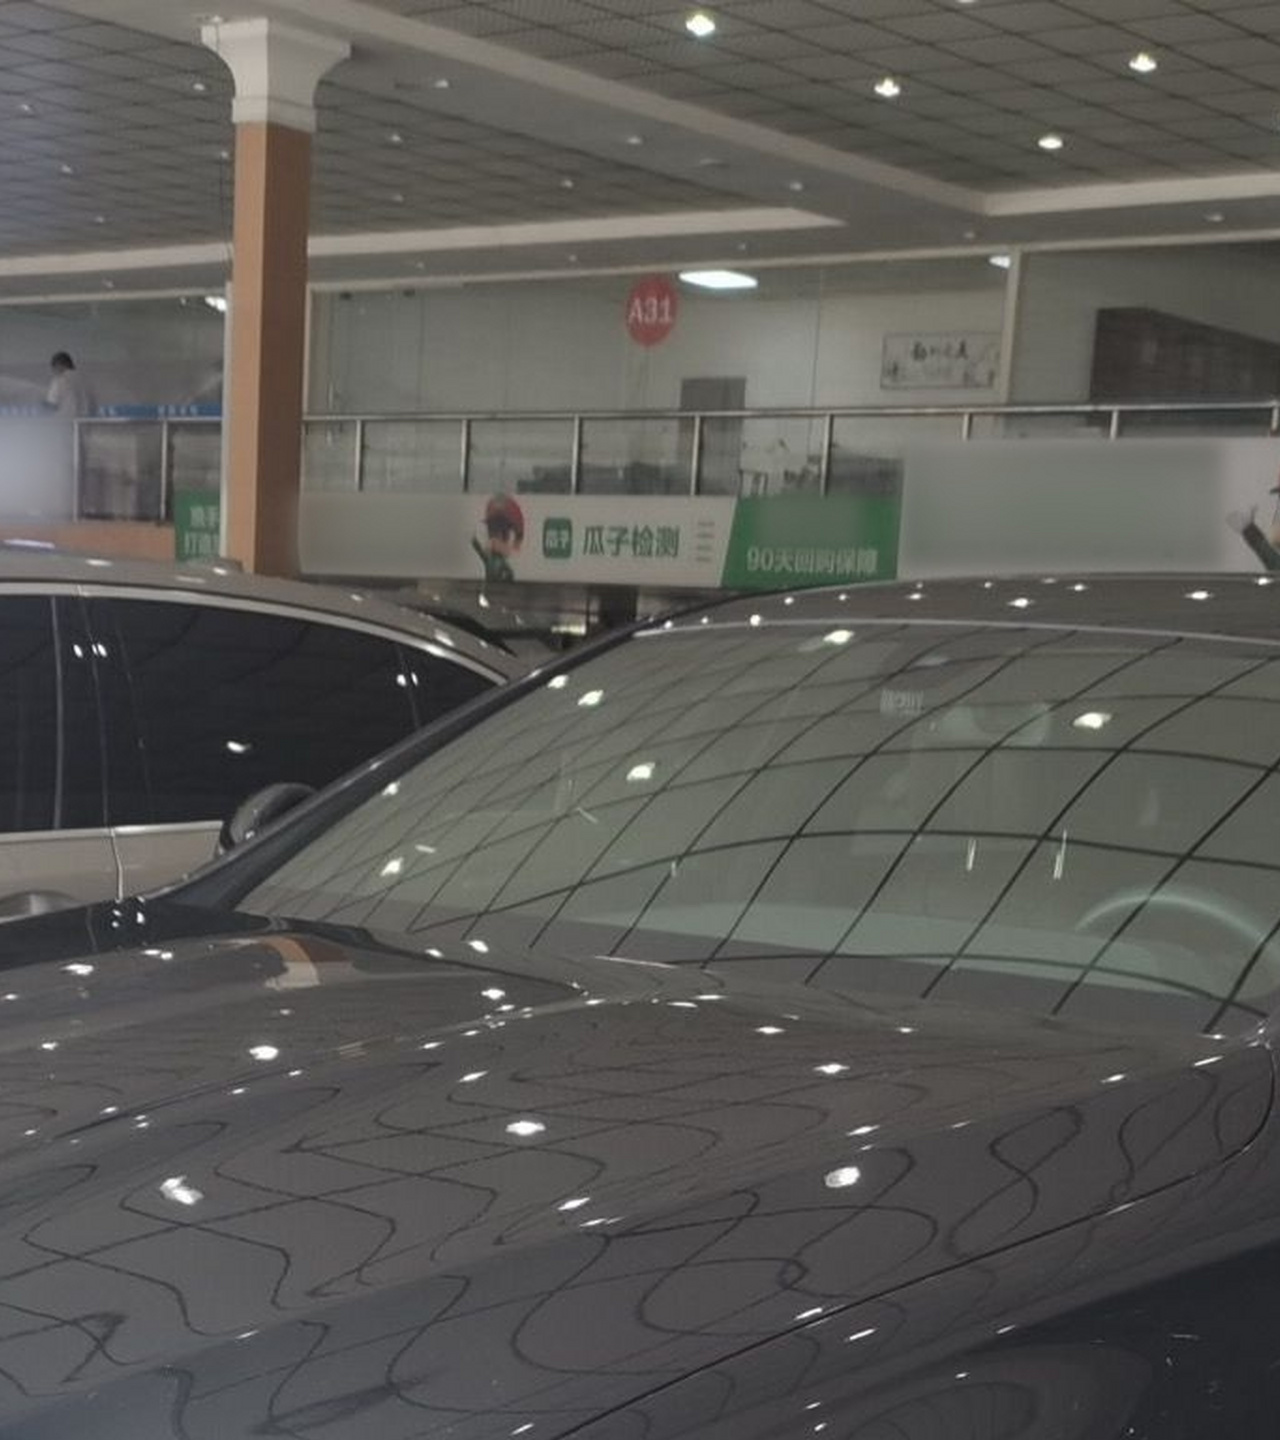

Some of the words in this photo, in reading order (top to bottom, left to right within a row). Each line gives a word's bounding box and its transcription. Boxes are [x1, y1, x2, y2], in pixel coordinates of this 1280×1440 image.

[628, 295, 671, 324] A31
[583, 525, 680, 558] 瓜子检测
[746, 546, 878, 575] 90天回购保障
